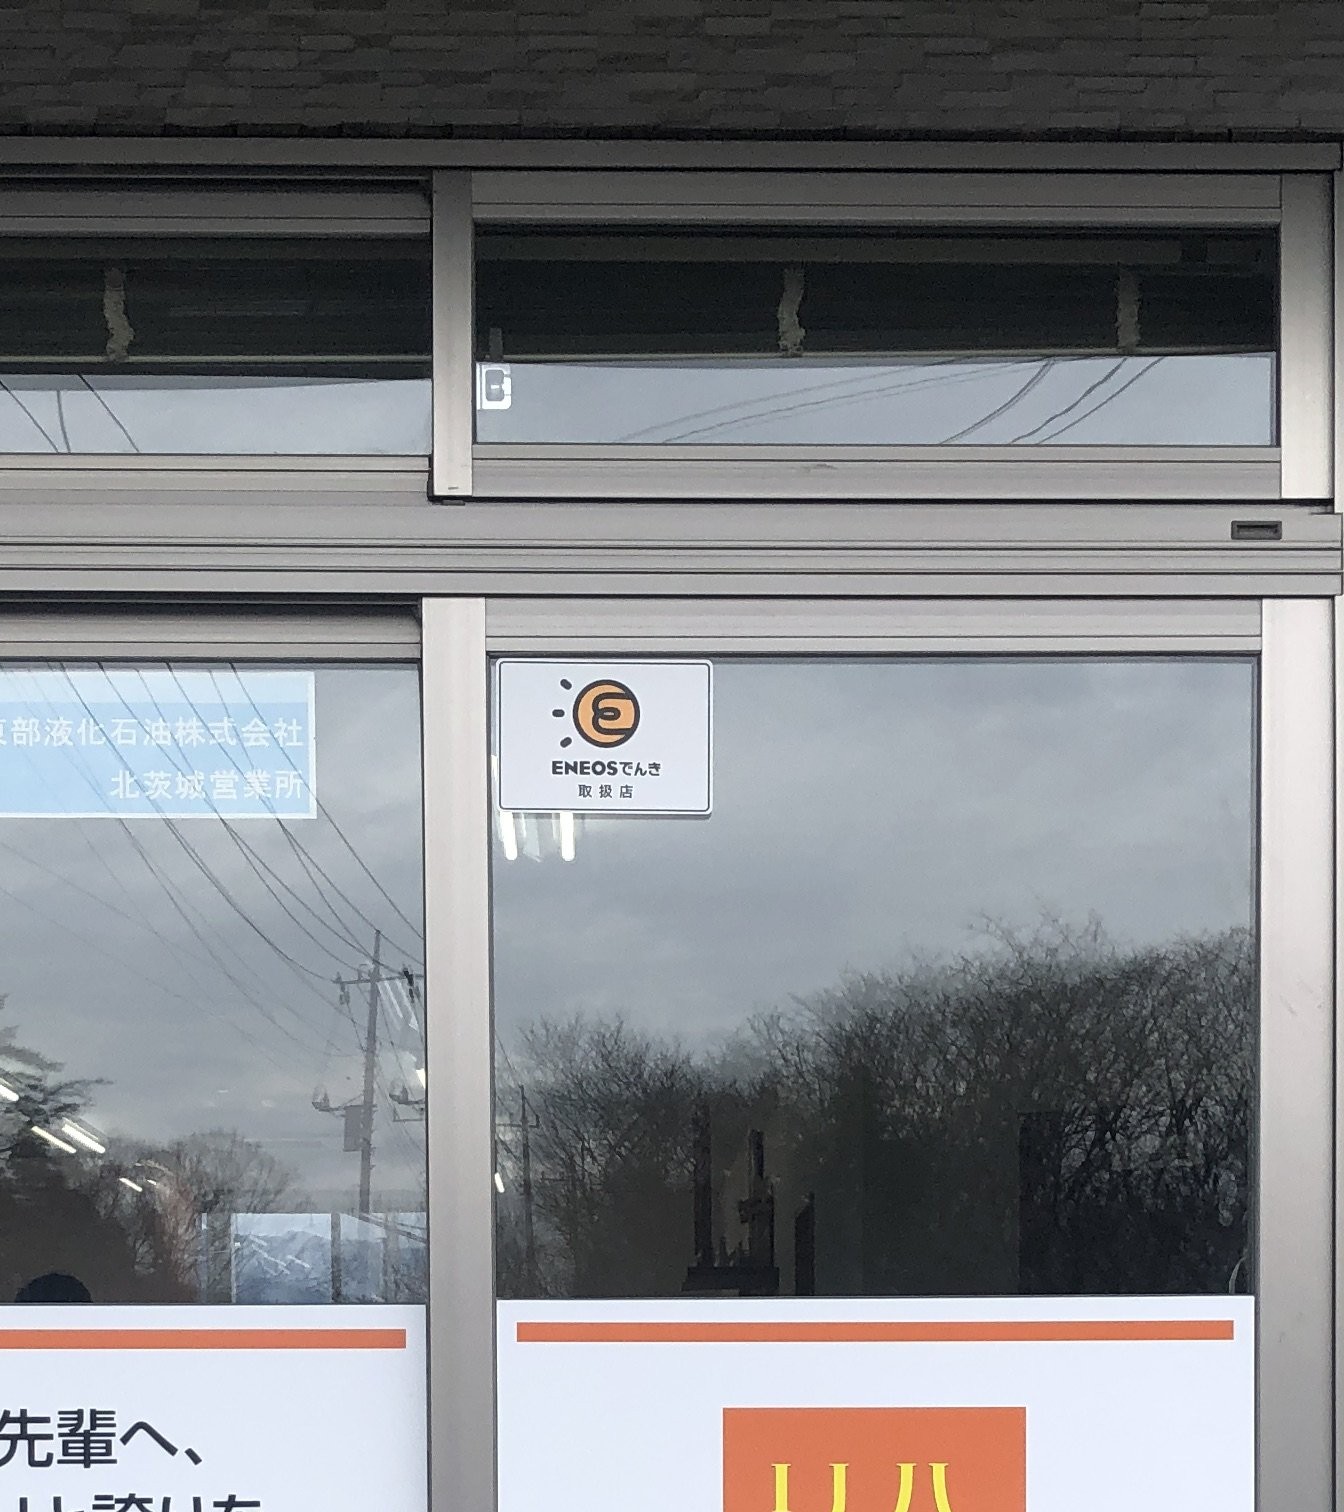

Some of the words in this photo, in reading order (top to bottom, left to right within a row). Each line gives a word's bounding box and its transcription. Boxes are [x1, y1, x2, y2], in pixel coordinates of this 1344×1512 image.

[551, 760, 661, 777] ENEOSでんき
[110, 768, 304, 800] 北茨城営業所
[578, 784, 634, 799] 取扱店
